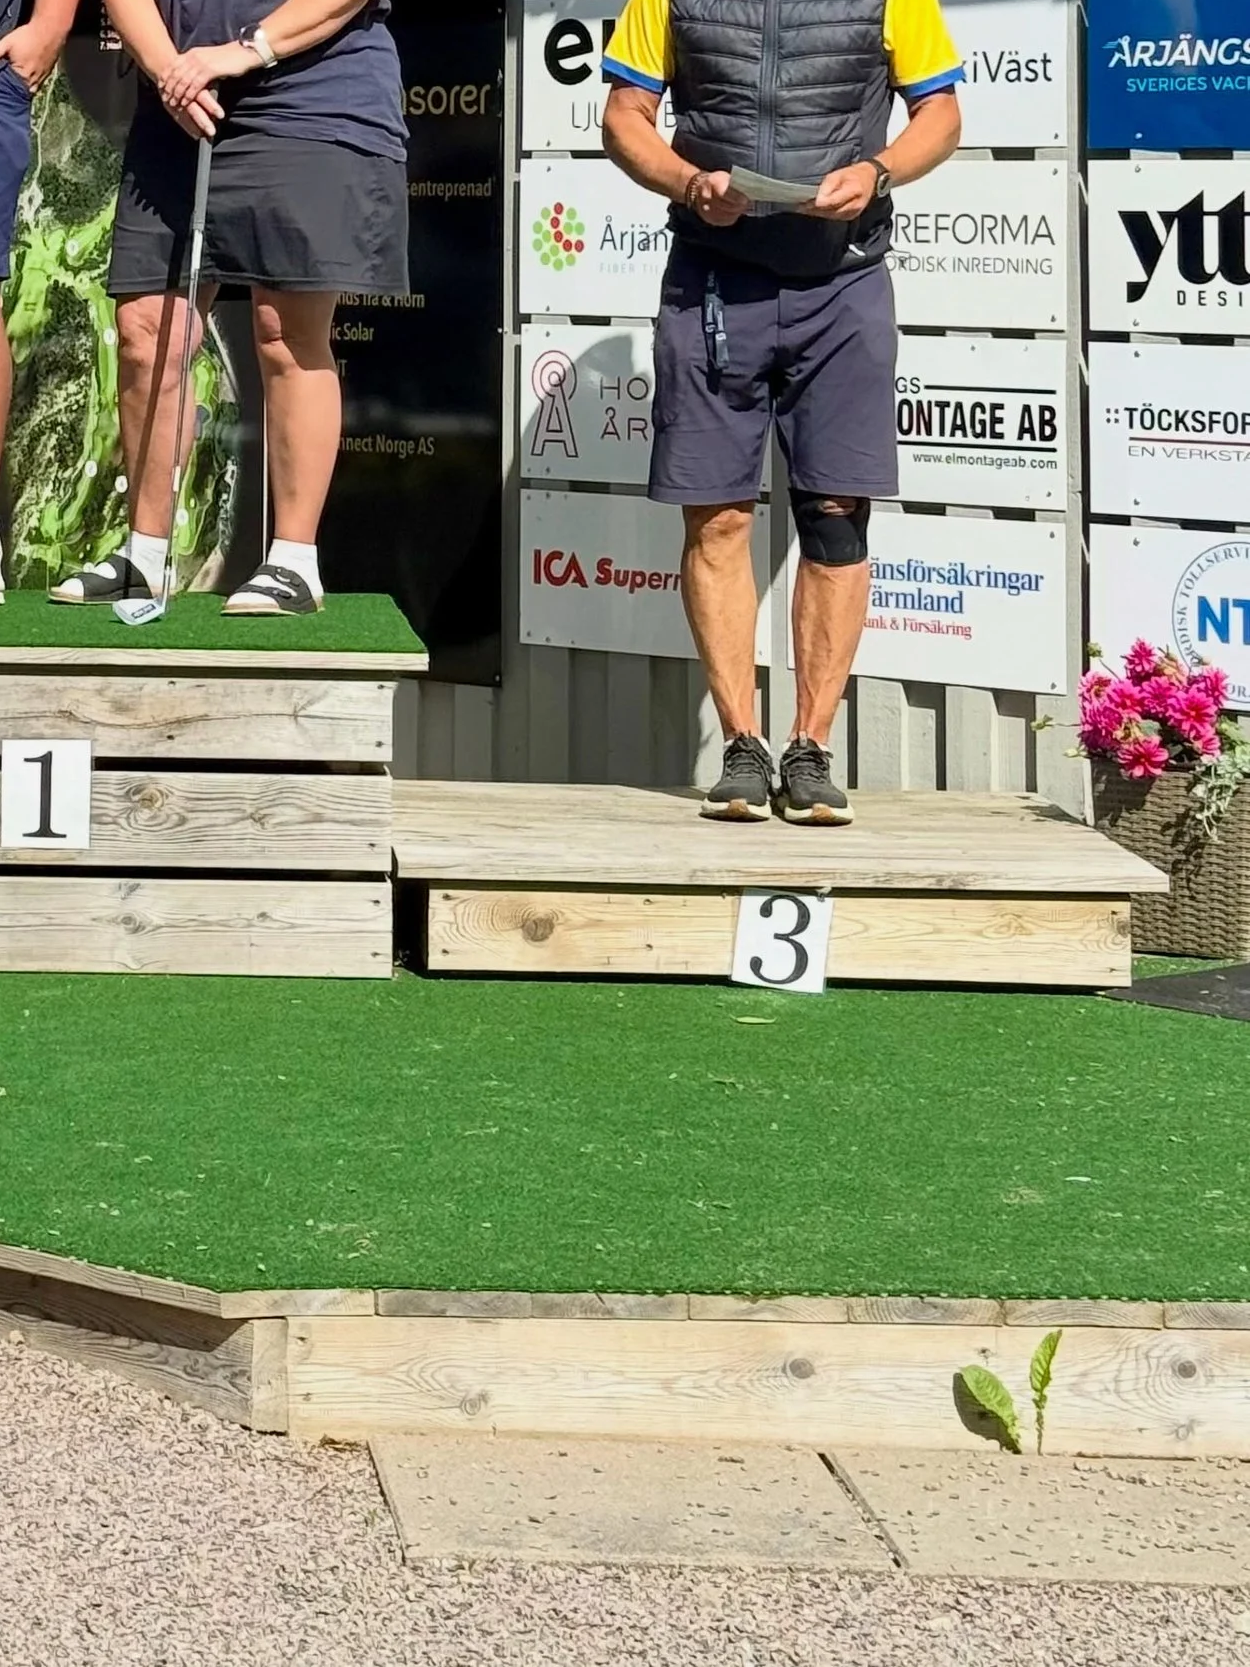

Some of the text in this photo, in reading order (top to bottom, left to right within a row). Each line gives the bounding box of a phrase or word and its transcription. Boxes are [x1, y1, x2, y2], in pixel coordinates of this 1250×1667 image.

[961, 49, 1052, 83] iVäst
[1126, 76, 1208, 92] SVERIGES
[407, 178, 493, 202] entreprenad
[895, 213, 1056, 246] REFORMA
[952, 256, 1053, 275] INREDNING
[1177, 290, 1243, 308] DESI
[343, 322, 375, 342] Solar
[600, 376, 648, 401] HO
[897, 398, 1058, 442] ONTAGE AB
[376, 435, 415, 459] Norge
[418, 437, 435, 456] AS
[1128, 445, 1155, 458] EN
[533, 548, 588, 589] ICA
[869, 584, 964, 615] ärmland
[22, 750, 67, 838] 1
[750, 895, 810, 984] 3
